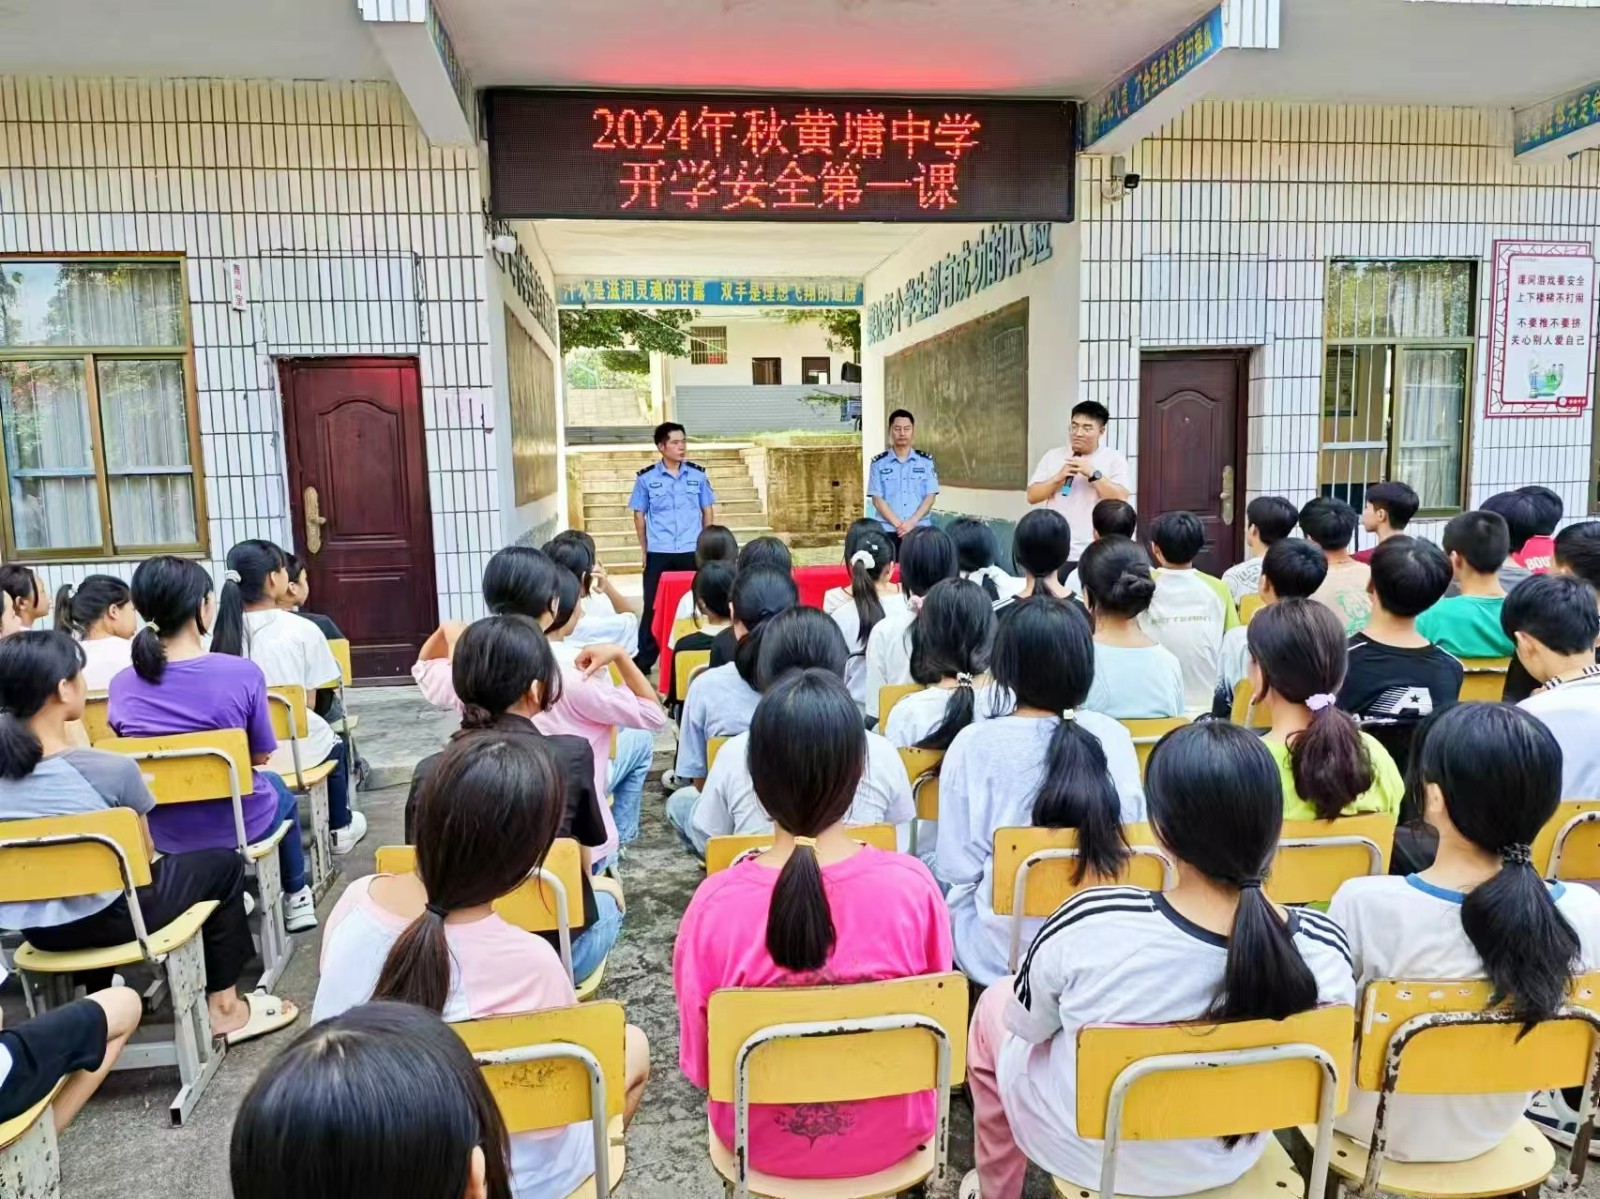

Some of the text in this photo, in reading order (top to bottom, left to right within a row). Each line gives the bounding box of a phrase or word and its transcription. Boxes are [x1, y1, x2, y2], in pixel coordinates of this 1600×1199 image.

[592, 105, 981, 160] 2024年秋黄塘中学
[619, 158, 959, 211] 开学安全第一课
[1517, 274, 1585, 287] 课间游戏要安全
[1516, 292, 1584, 304] 上下楼梯不打闹
[1517, 317, 1581, 329] 不要推不要挤
[1511, 334, 1585, 346] 关心别人爱自己
